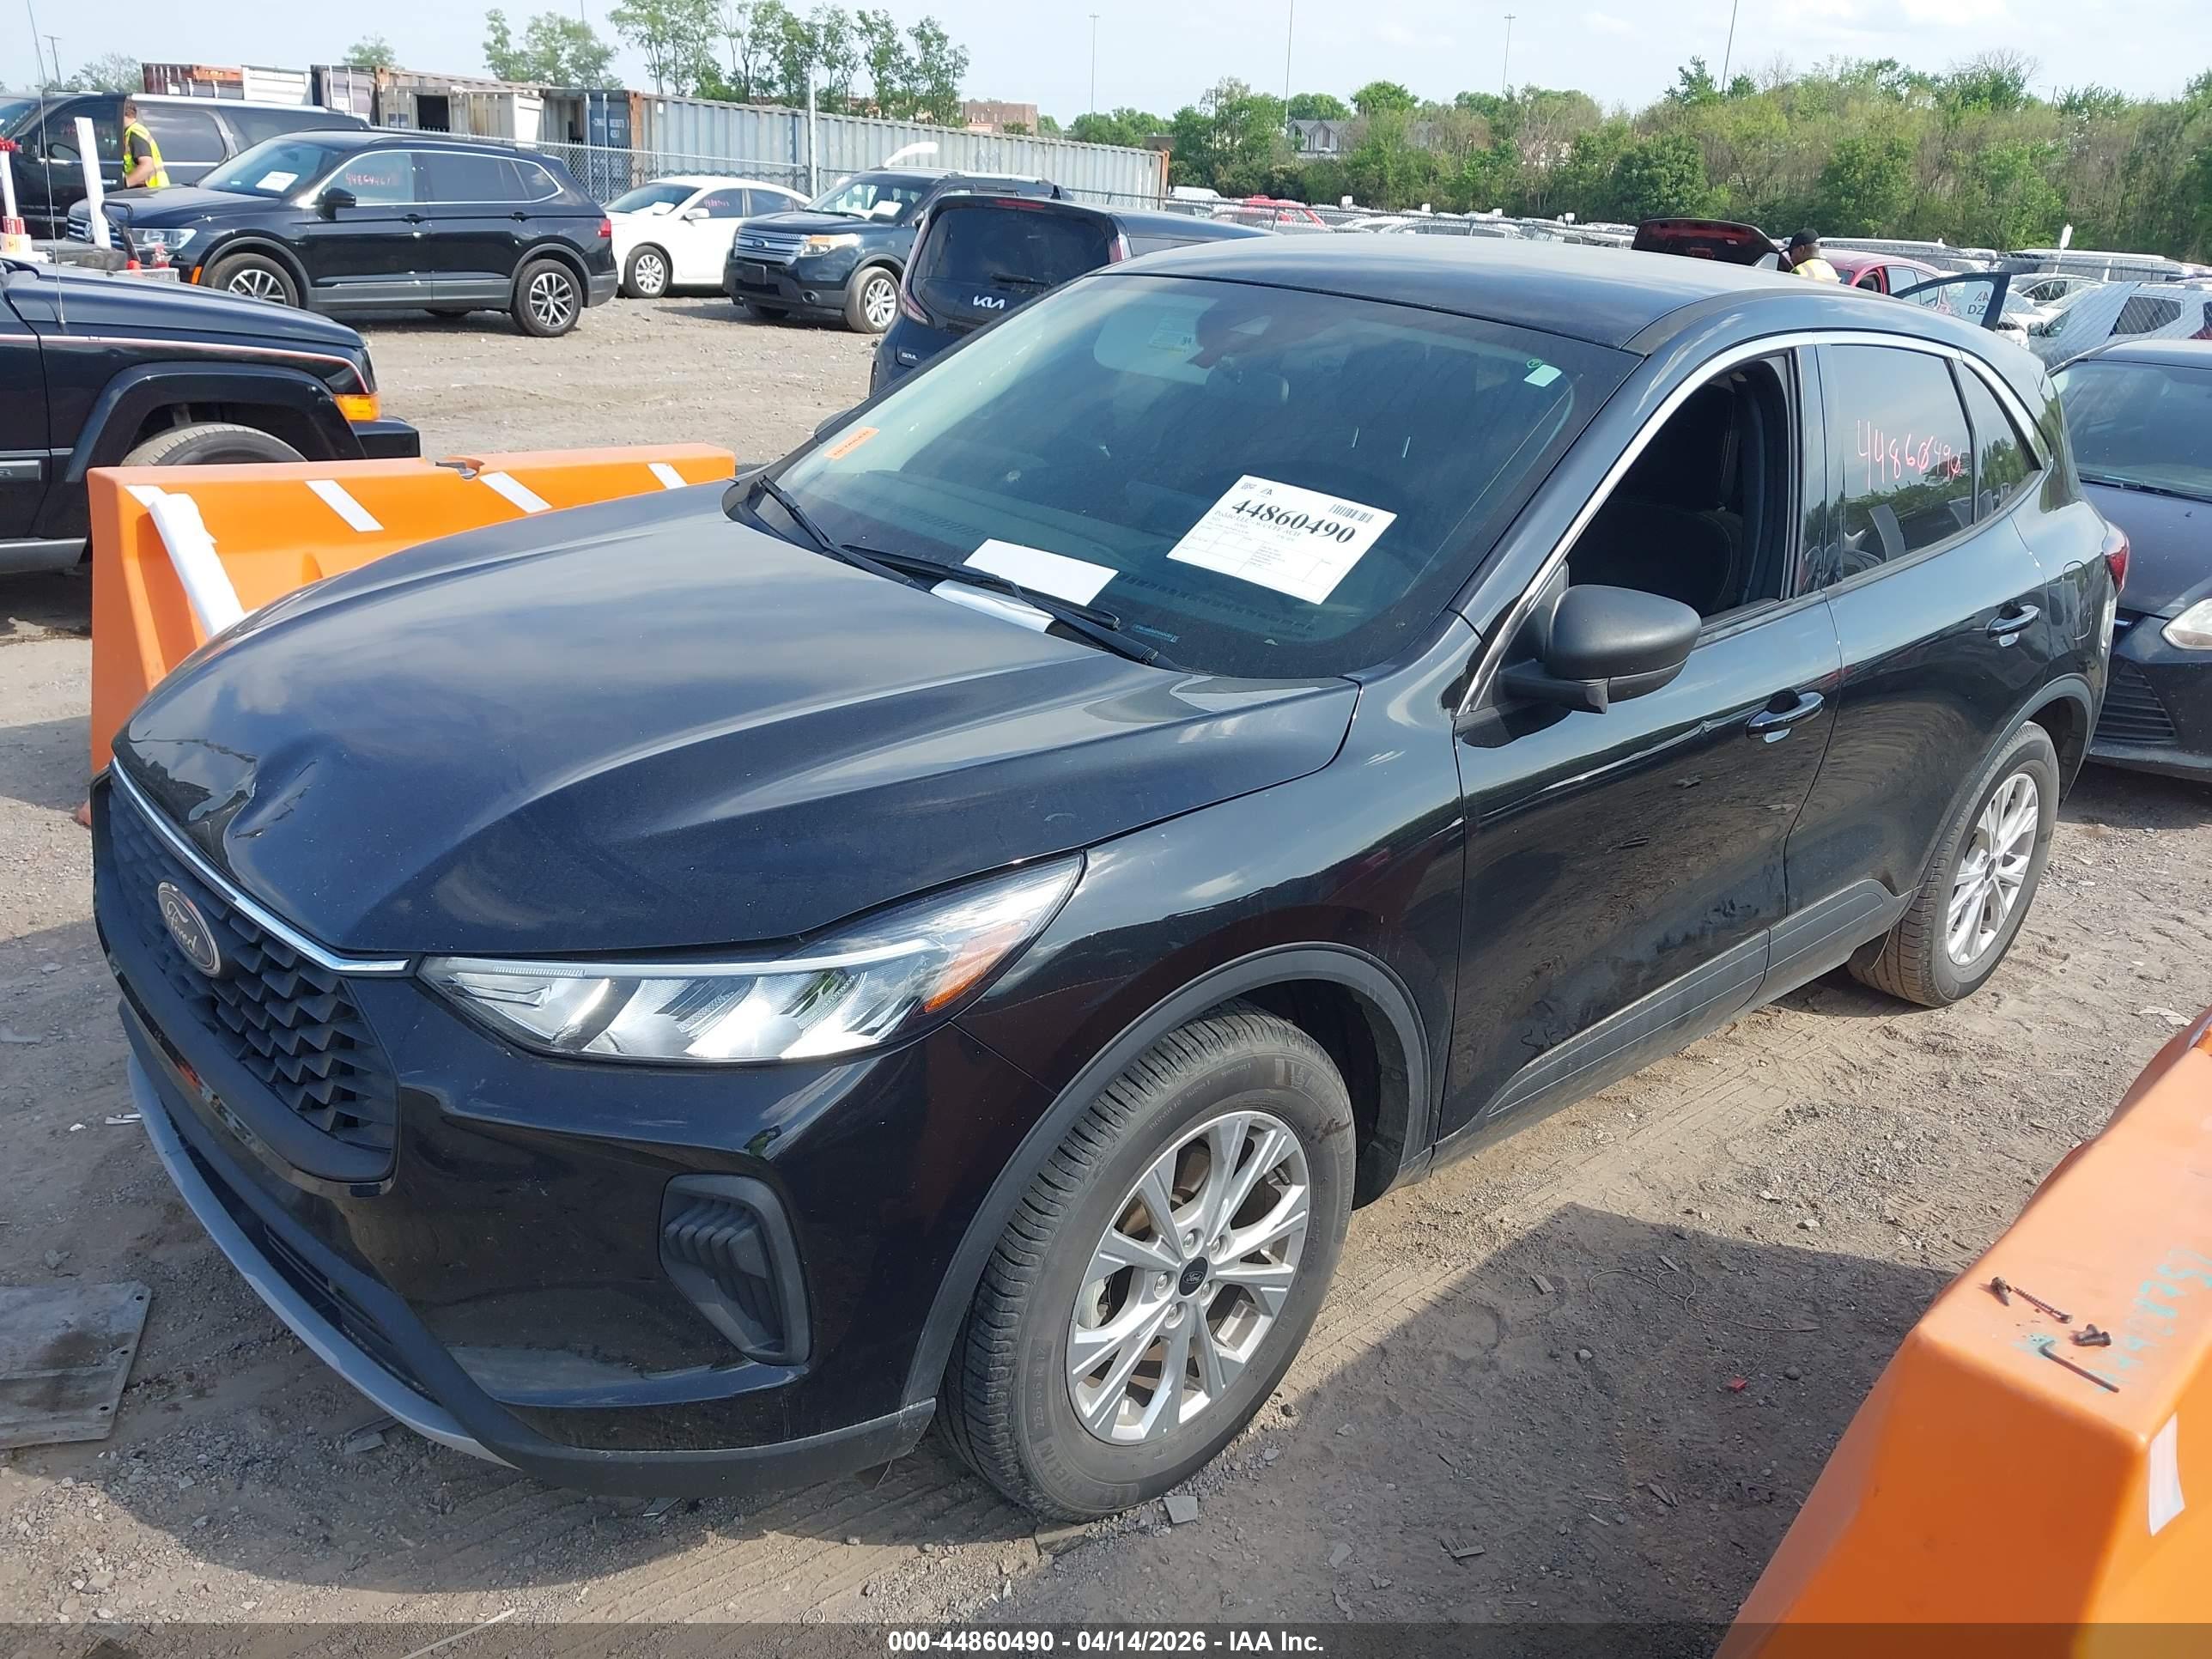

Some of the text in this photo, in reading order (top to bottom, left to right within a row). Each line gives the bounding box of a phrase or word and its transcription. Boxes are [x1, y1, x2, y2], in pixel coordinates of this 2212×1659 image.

[972, 295, 1006, 310] KIA
[1231, 499, 1357, 544] 44860490
[167, 901, 199, 958] Ford
